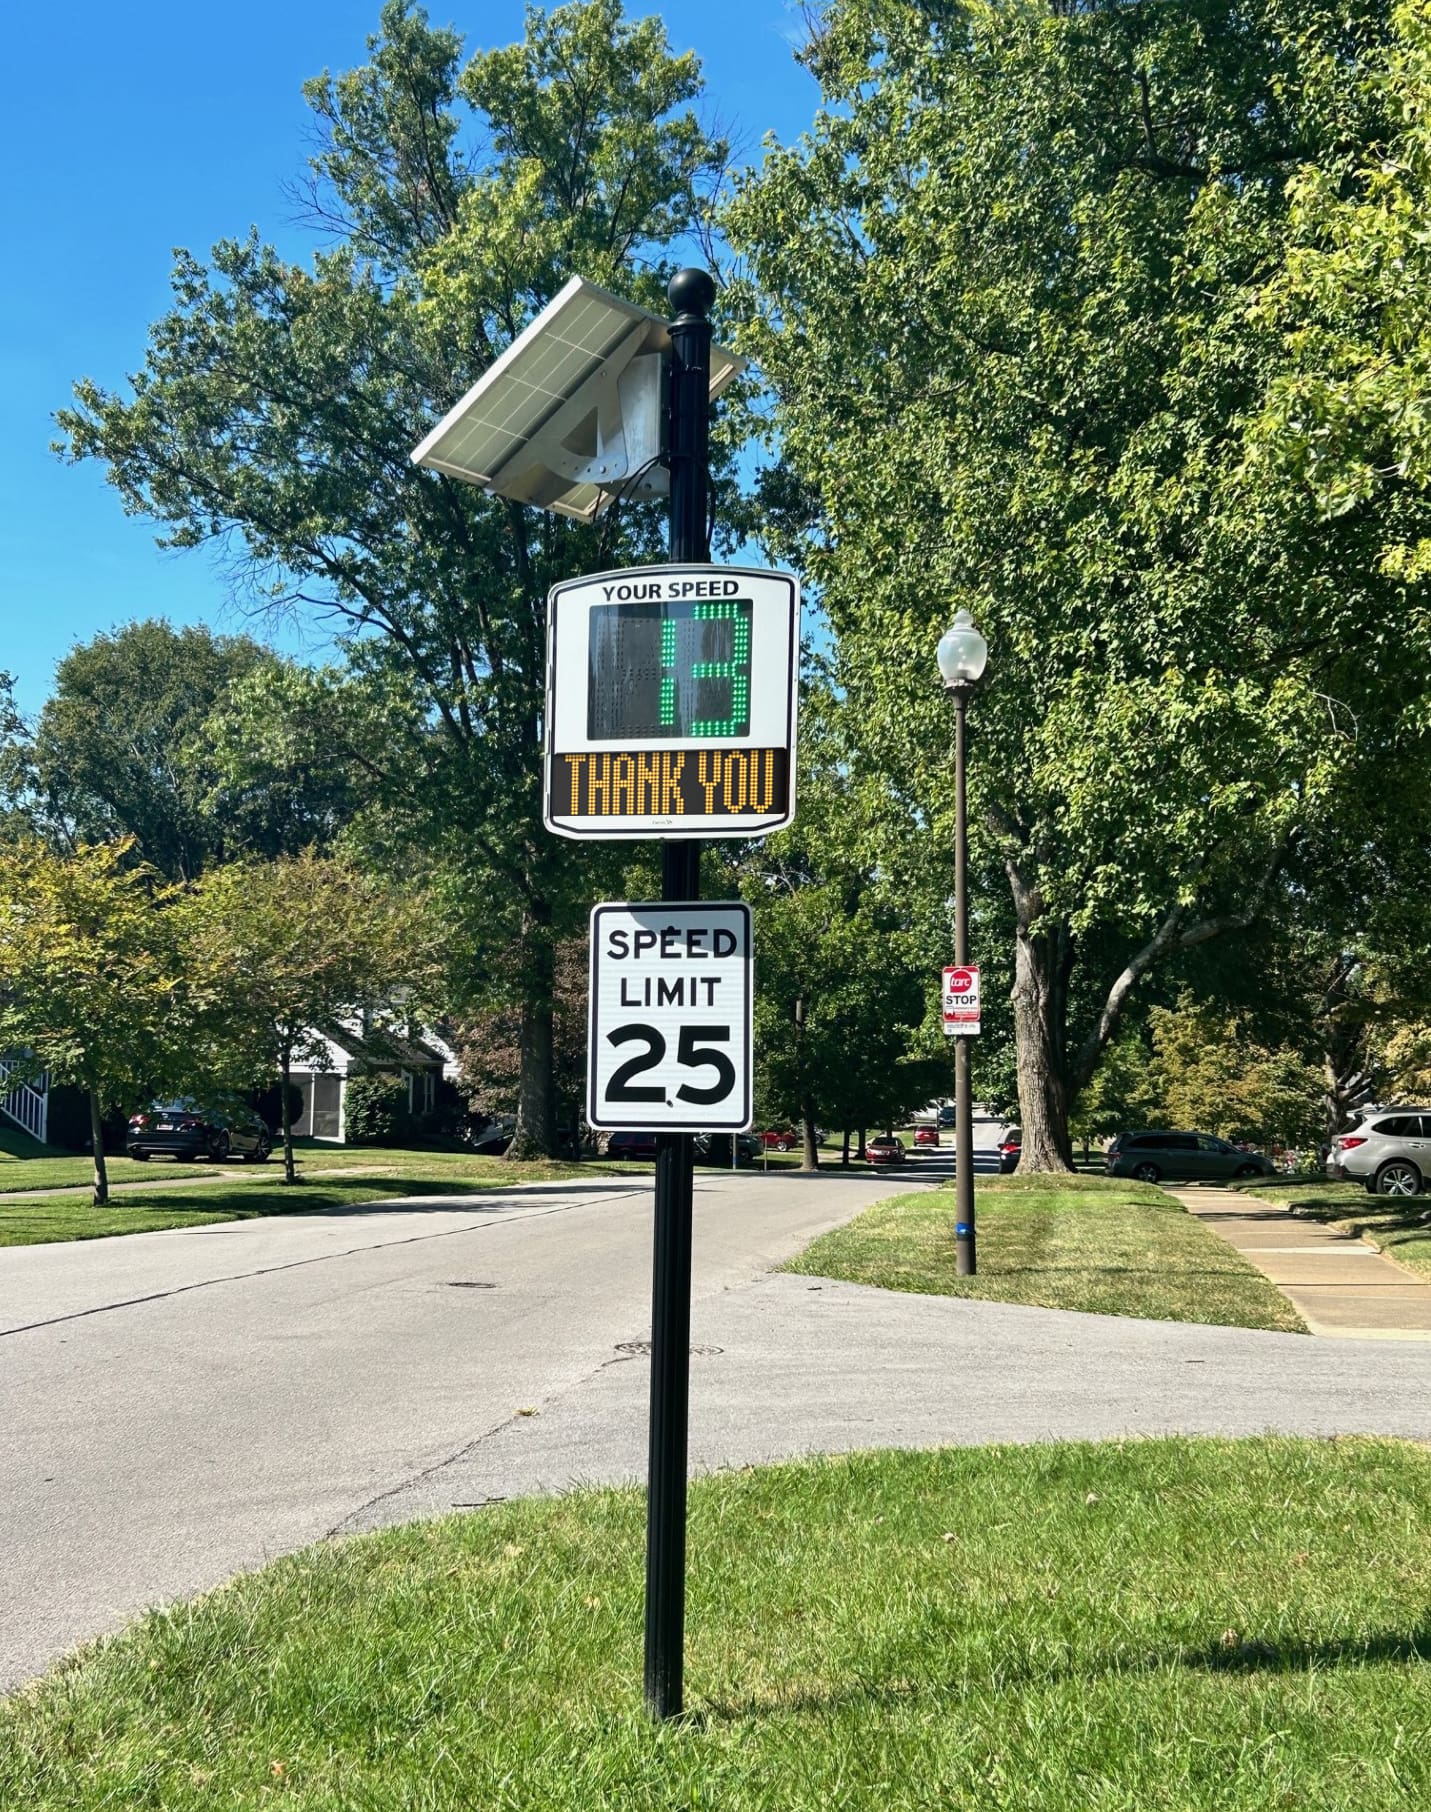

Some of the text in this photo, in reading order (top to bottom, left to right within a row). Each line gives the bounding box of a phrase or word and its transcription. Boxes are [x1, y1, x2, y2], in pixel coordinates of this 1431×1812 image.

[602, 580, 739, 601] YOUR SPEED
[660, 604, 748, 736] 13
[565, 750, 774, 815] THANK YOU
[607, 928, 737, 960] SPEED
[621, 977, 722, 1007] LIMIT
[945, 995, 977, 1005] STOP
[605, 1023, 736, 1105] 25
